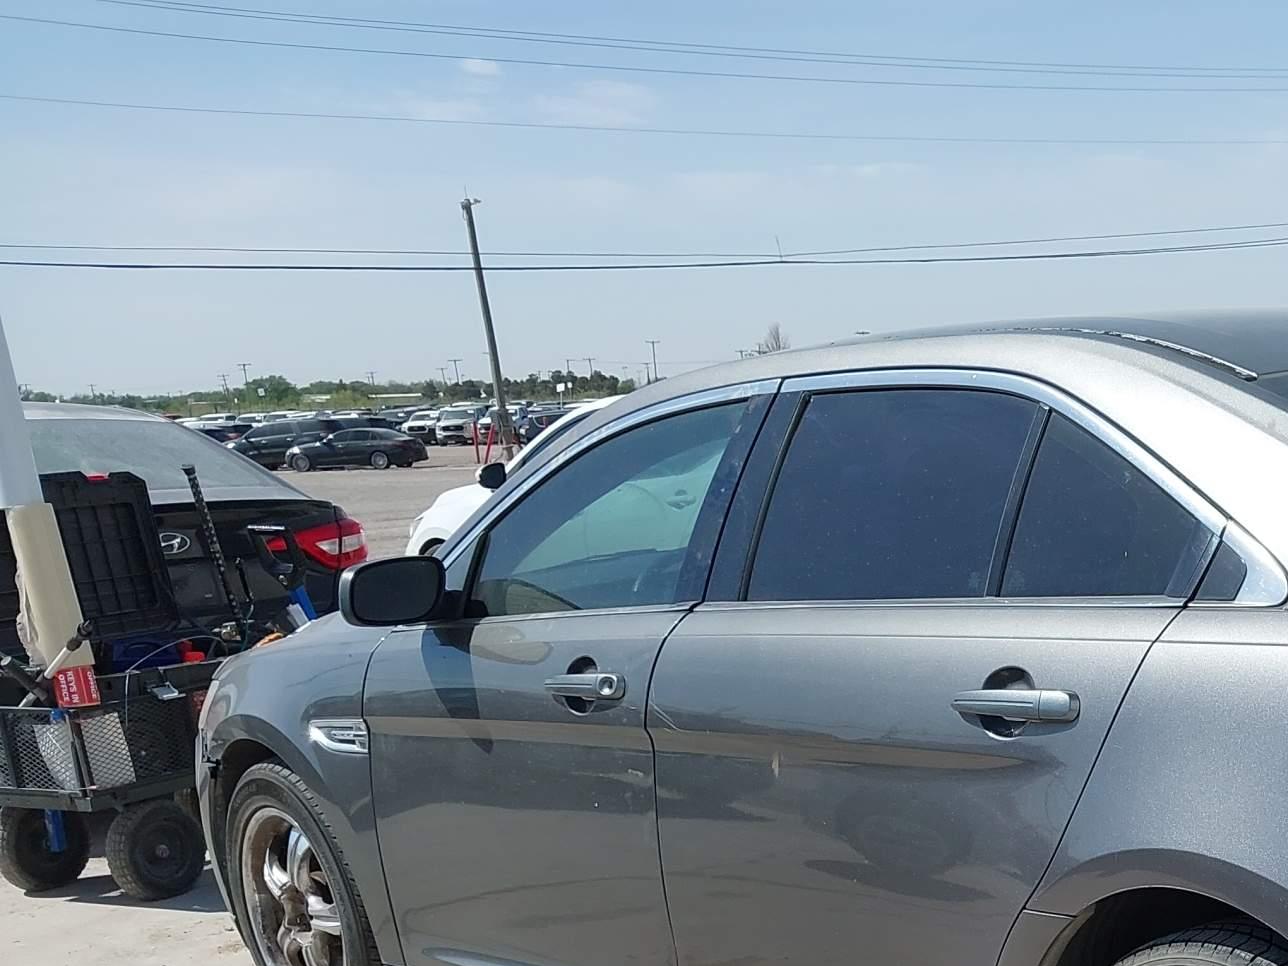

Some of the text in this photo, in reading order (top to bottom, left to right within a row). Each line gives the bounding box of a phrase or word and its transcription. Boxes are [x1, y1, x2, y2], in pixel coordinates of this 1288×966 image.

[58, 674, 71, 702] OFFICE
[66, 671, 80, 703] KEYS IN
